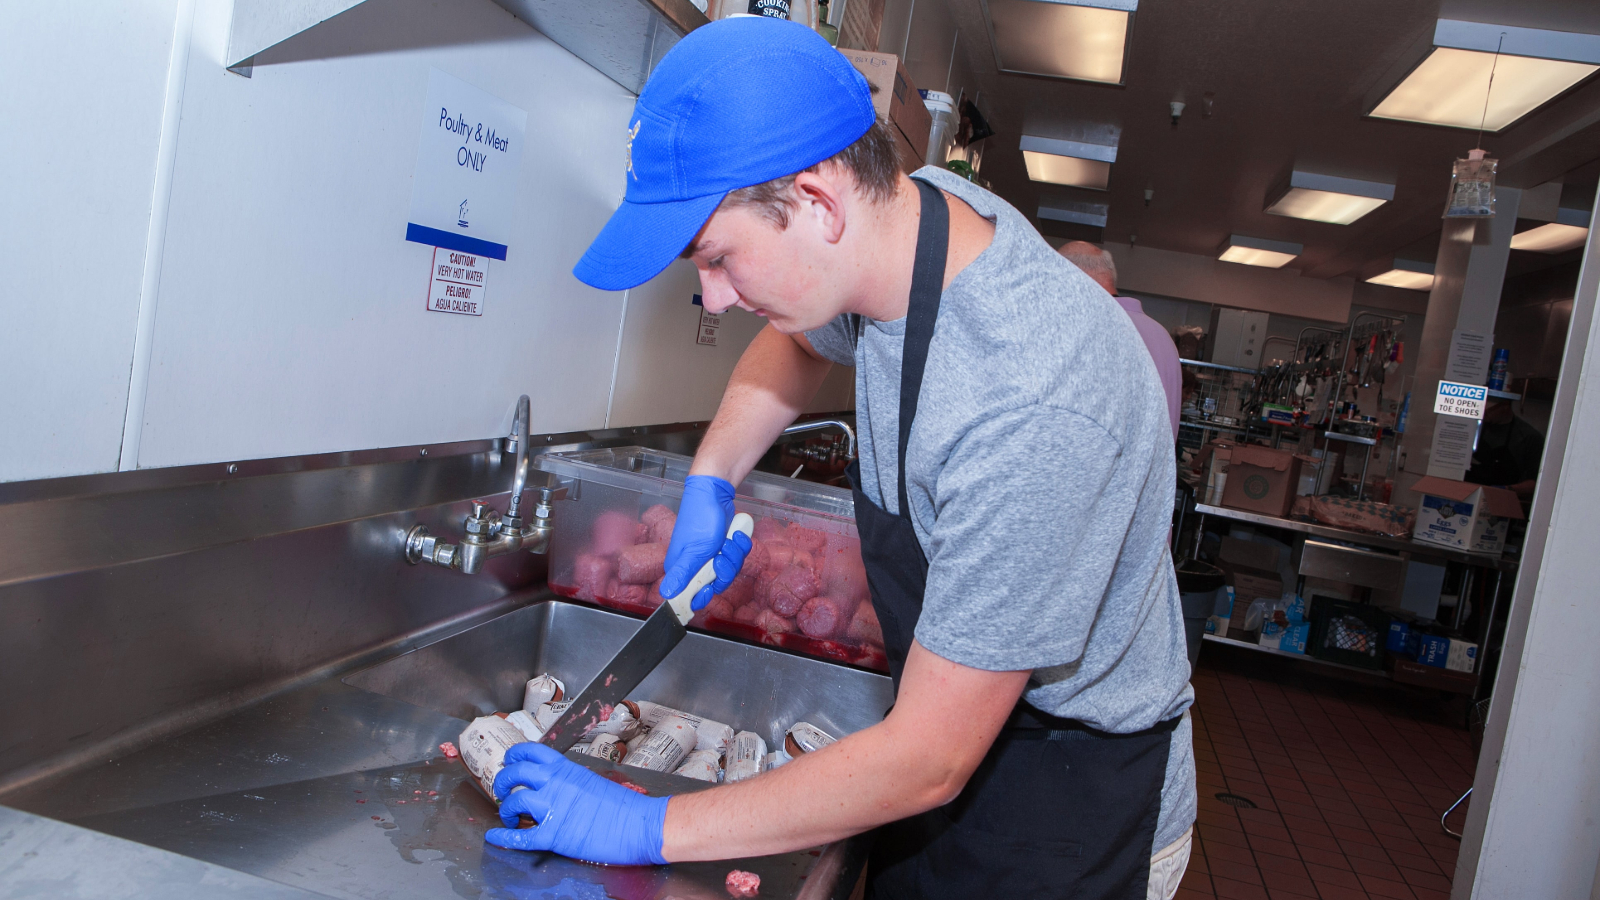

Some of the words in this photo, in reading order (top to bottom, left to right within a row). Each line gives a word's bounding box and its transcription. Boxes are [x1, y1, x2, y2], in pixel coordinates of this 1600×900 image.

[439, 107, 473, 144] Poultry
[474, 122, 482, 143] &
[485, 127, 509, 153] Meat
[457, 146, 487, 173] ONLY
[450, 252, 476, 267] CAUTION!
[438, 265, 453, 277] VERY
[453, 268, 465, 279] HOT
[465, 270, 484, 283] WATER
[446, 285, 471, 299] PELIGRO!
[435, 298, 451, 311] AGUA
[452, 300, 477, 313] CALIENTE
[1441, 384, 1484, 399] NOTICE
[1444, 397, 1455, 405] NO
[1439, 404, 1453, 413] TOE
[1455, 406, 1479, 416] SHOES
[1437, 517, 1451, 527] Eggs
[1291, 626, 1301, 647] CLEAR
[1427, 640, 1437, 663] TRASH
